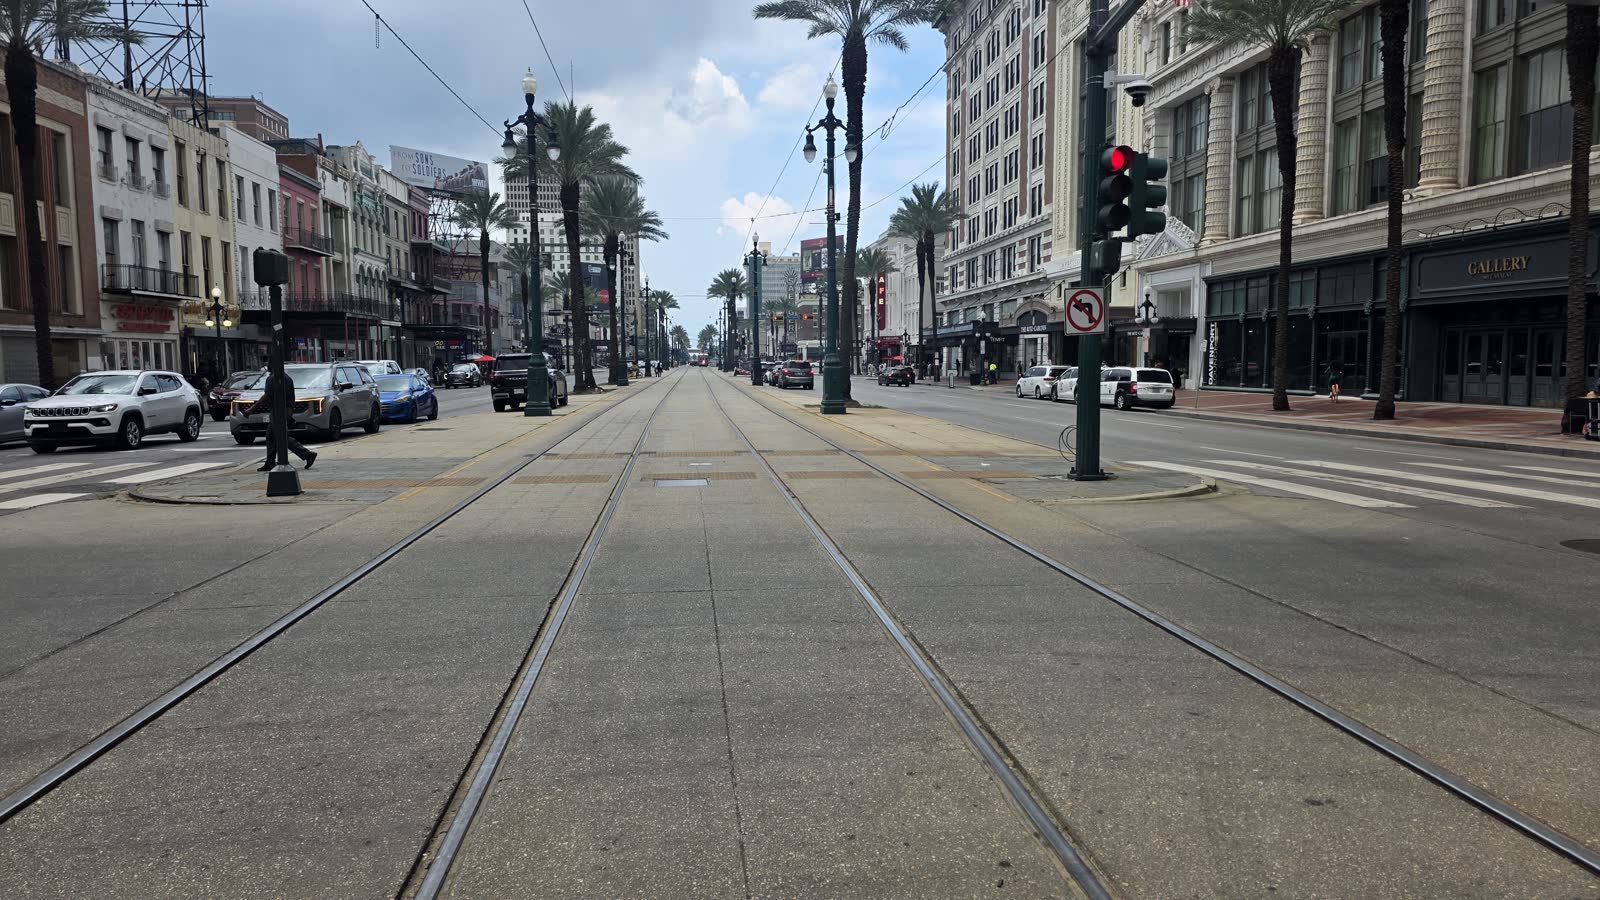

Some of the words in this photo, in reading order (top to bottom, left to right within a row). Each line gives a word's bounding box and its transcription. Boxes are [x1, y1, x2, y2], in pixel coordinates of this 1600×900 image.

[393, 151, 414, 160] FROM
[415, 152, 434, 166] SONS
[412, 163, 447, 180] SOLDIERS
[1467, 256, 1530, 274] GALLERY
[788, 277, 796, 331] SAEGER
